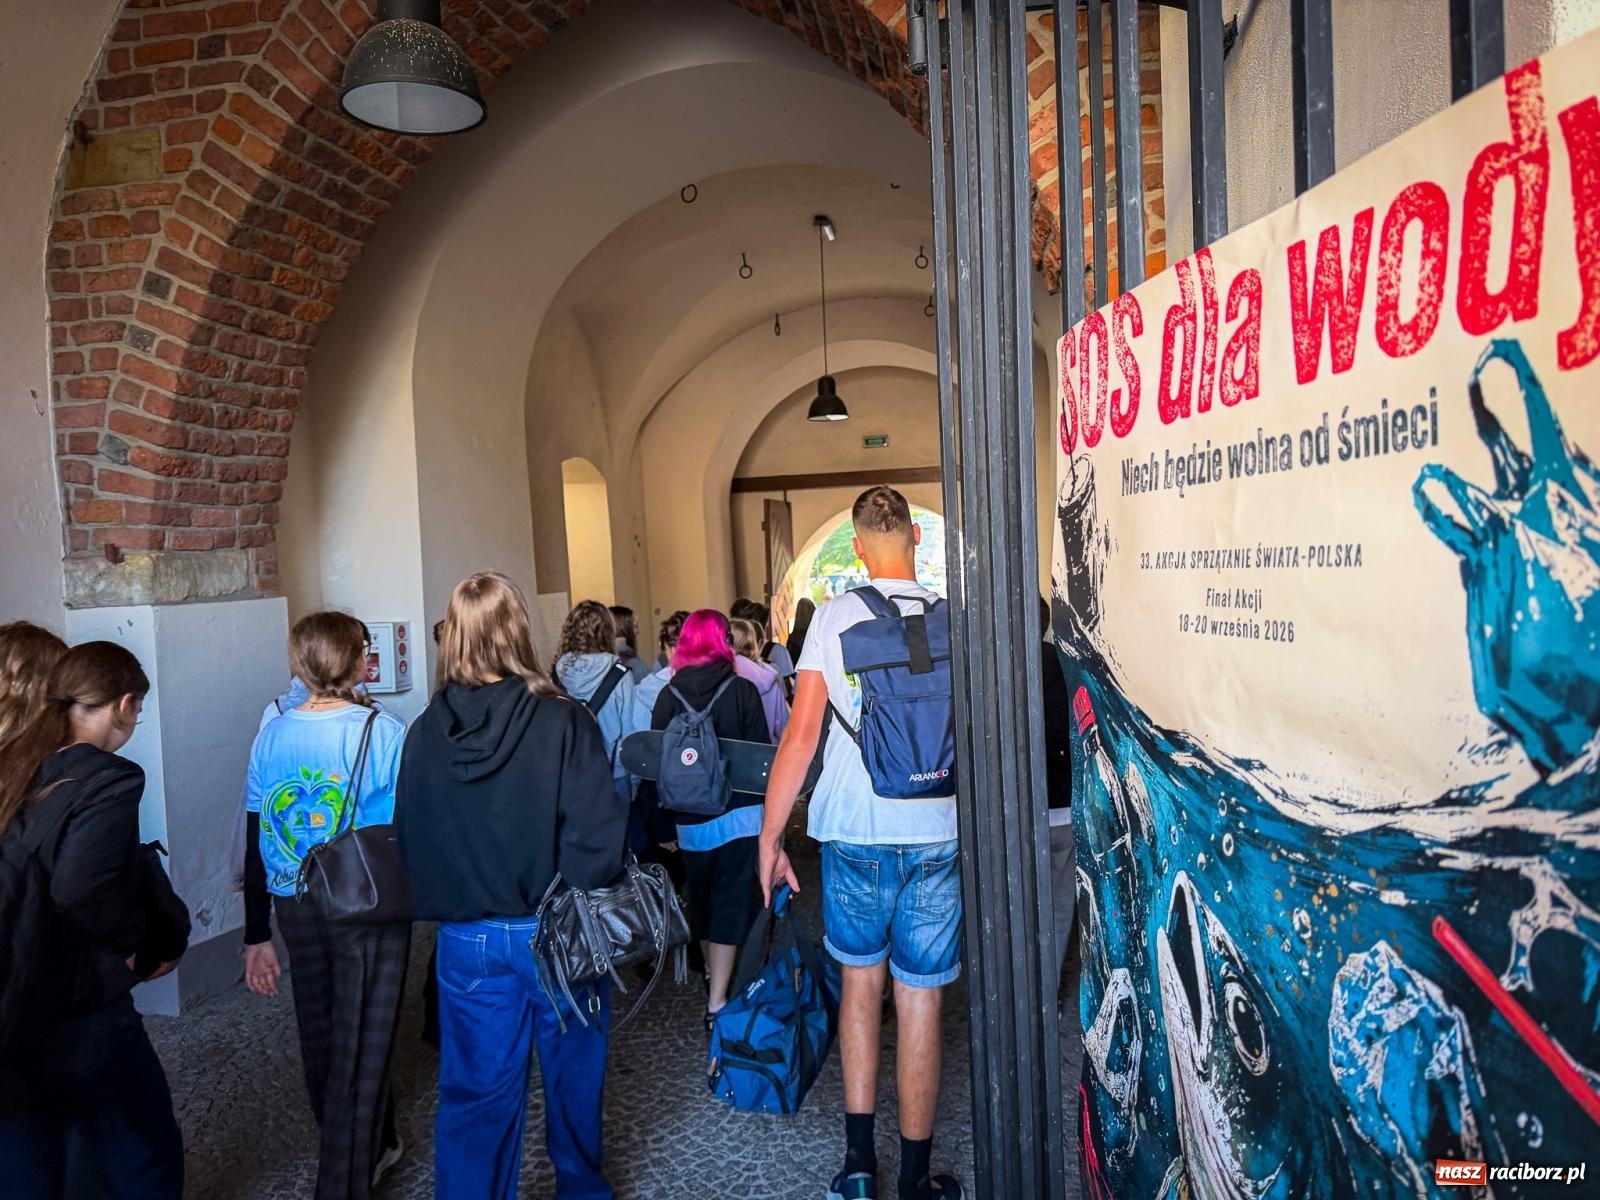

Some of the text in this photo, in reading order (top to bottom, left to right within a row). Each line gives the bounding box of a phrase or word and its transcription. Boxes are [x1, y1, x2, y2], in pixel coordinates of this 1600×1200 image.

[1060, 292, 1143, 455] SOS
[1158, 246, 1263, 424] dla
[1121, 386, 1439, 498] Niech będzie wolna od śmieci
[1140, 552, 1152, 570] 33.
[1155, 551, 1187, 570] AKCJA
[1190, 548, 1251, 573] SPRZĄTANIE
[1234, 588, 1262, 613] Akcji
[1178, 613, 1295, 643] 18-20 września 2026
